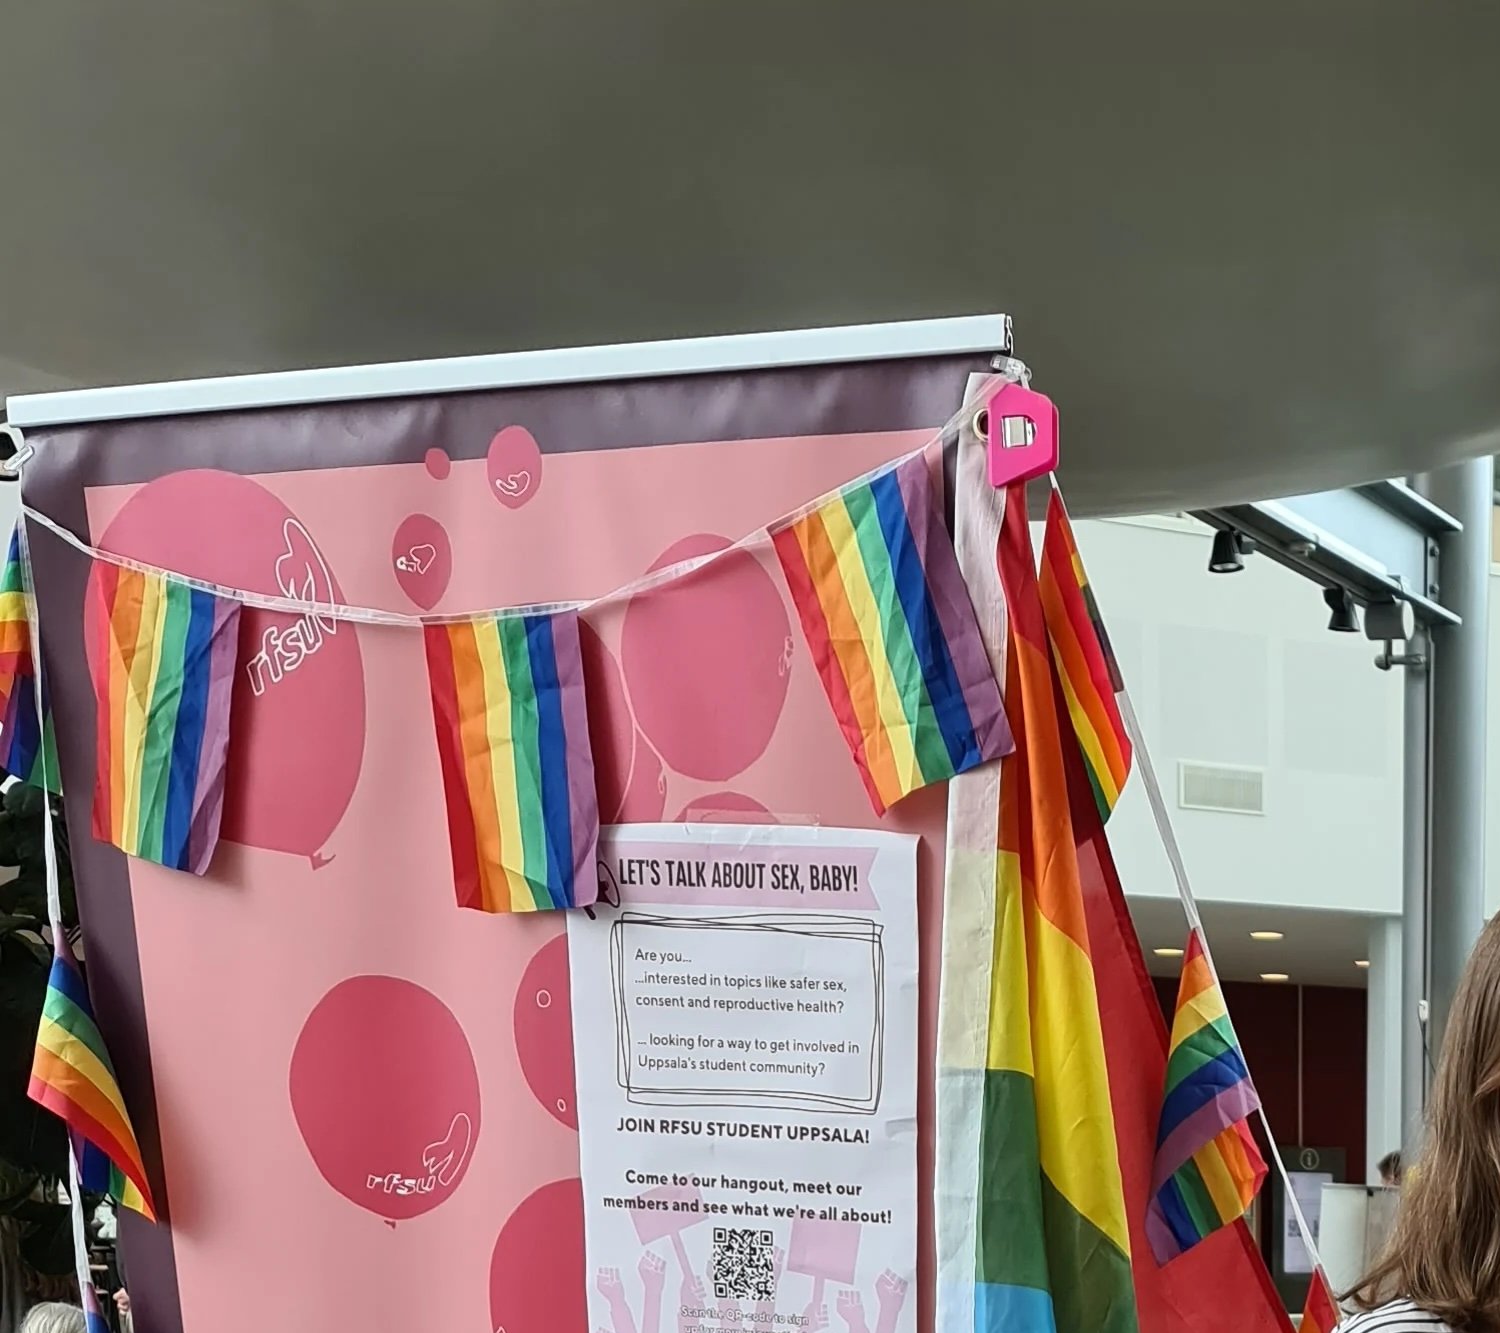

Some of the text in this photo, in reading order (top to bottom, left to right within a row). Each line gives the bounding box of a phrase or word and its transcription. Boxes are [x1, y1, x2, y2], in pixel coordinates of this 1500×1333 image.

[246, 612, 322, 696] rfsu
[619, 859, 858, 894] LET'S TALK ABOUT SEX, BABY!
[634, 949, 692, 965] Are you...
[634, 972, 847, 993] ...interested in topics like safer sex,
[635, 994, 844, 1014] consent and reproductive health?
[649, 1034, 859, 1054] looking for a way to get involved in
[638, 1055, 826, 1077] Uppsala's student community?
[617, 1117, 870, 1144] JOIN RFSU STUDENT UPPSALA!
[366, 1174, 436, 1195] rfsu
[625, 1170, 862, 1196] Come to our hangout, meet our
[602, 1196, 892, 1224] members and see what we're all about!
[680, 1305, 810, 1328] Scan the QR-code to sign
